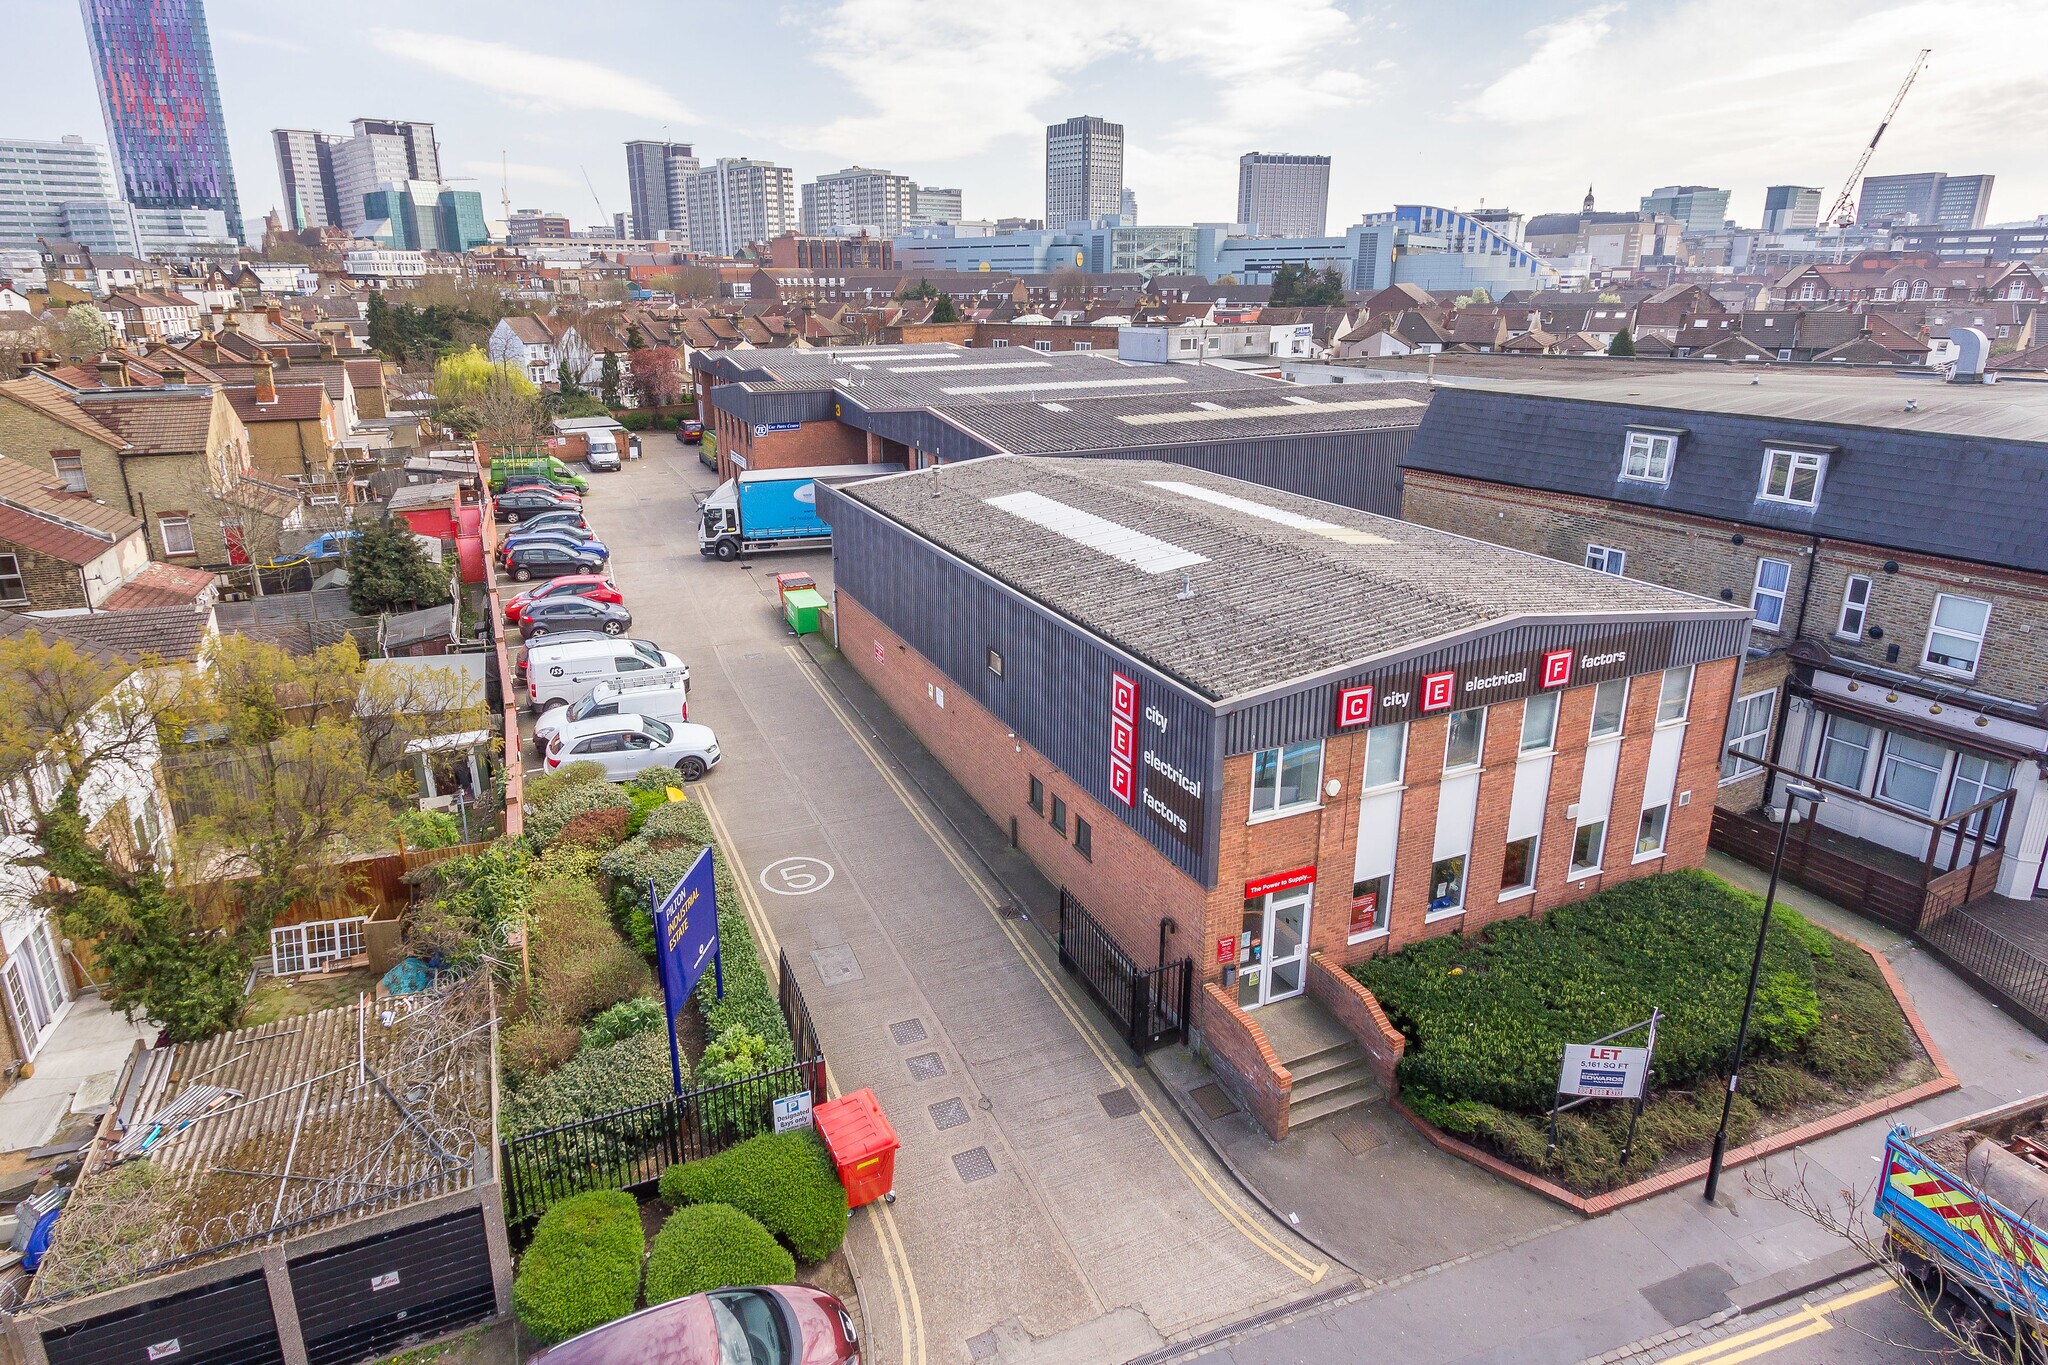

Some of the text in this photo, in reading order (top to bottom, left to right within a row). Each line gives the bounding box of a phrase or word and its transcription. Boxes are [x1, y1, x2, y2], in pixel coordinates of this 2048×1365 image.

[835, 404, 841, 417] 3
[1350, 651, 1627, 716] C city E electrical F factors
[1145, 705, 1168, 734] city
[1144, 749, 1201, 800] electrical
[1142, 788, 1188, 834] factors
[780, 864, 816, 888] 5
[1262, 881, 1280, 891] Power
[665, 886, 687, 921] PILTON
[667, 887, 700, 937] INDUSTRIAL
[669, 917, 689, 953] ESTATE
[1580, 1061, 1600, 1069] 5,161
[1603, 1062, 1616, 1070] SQ
[1590, 1048, 1622, 1060] LET
[777, 1108, 810, 1122] Designated
[780, 1120, 794, 1128] Bays
[794, 1115, 808, 1124] only
